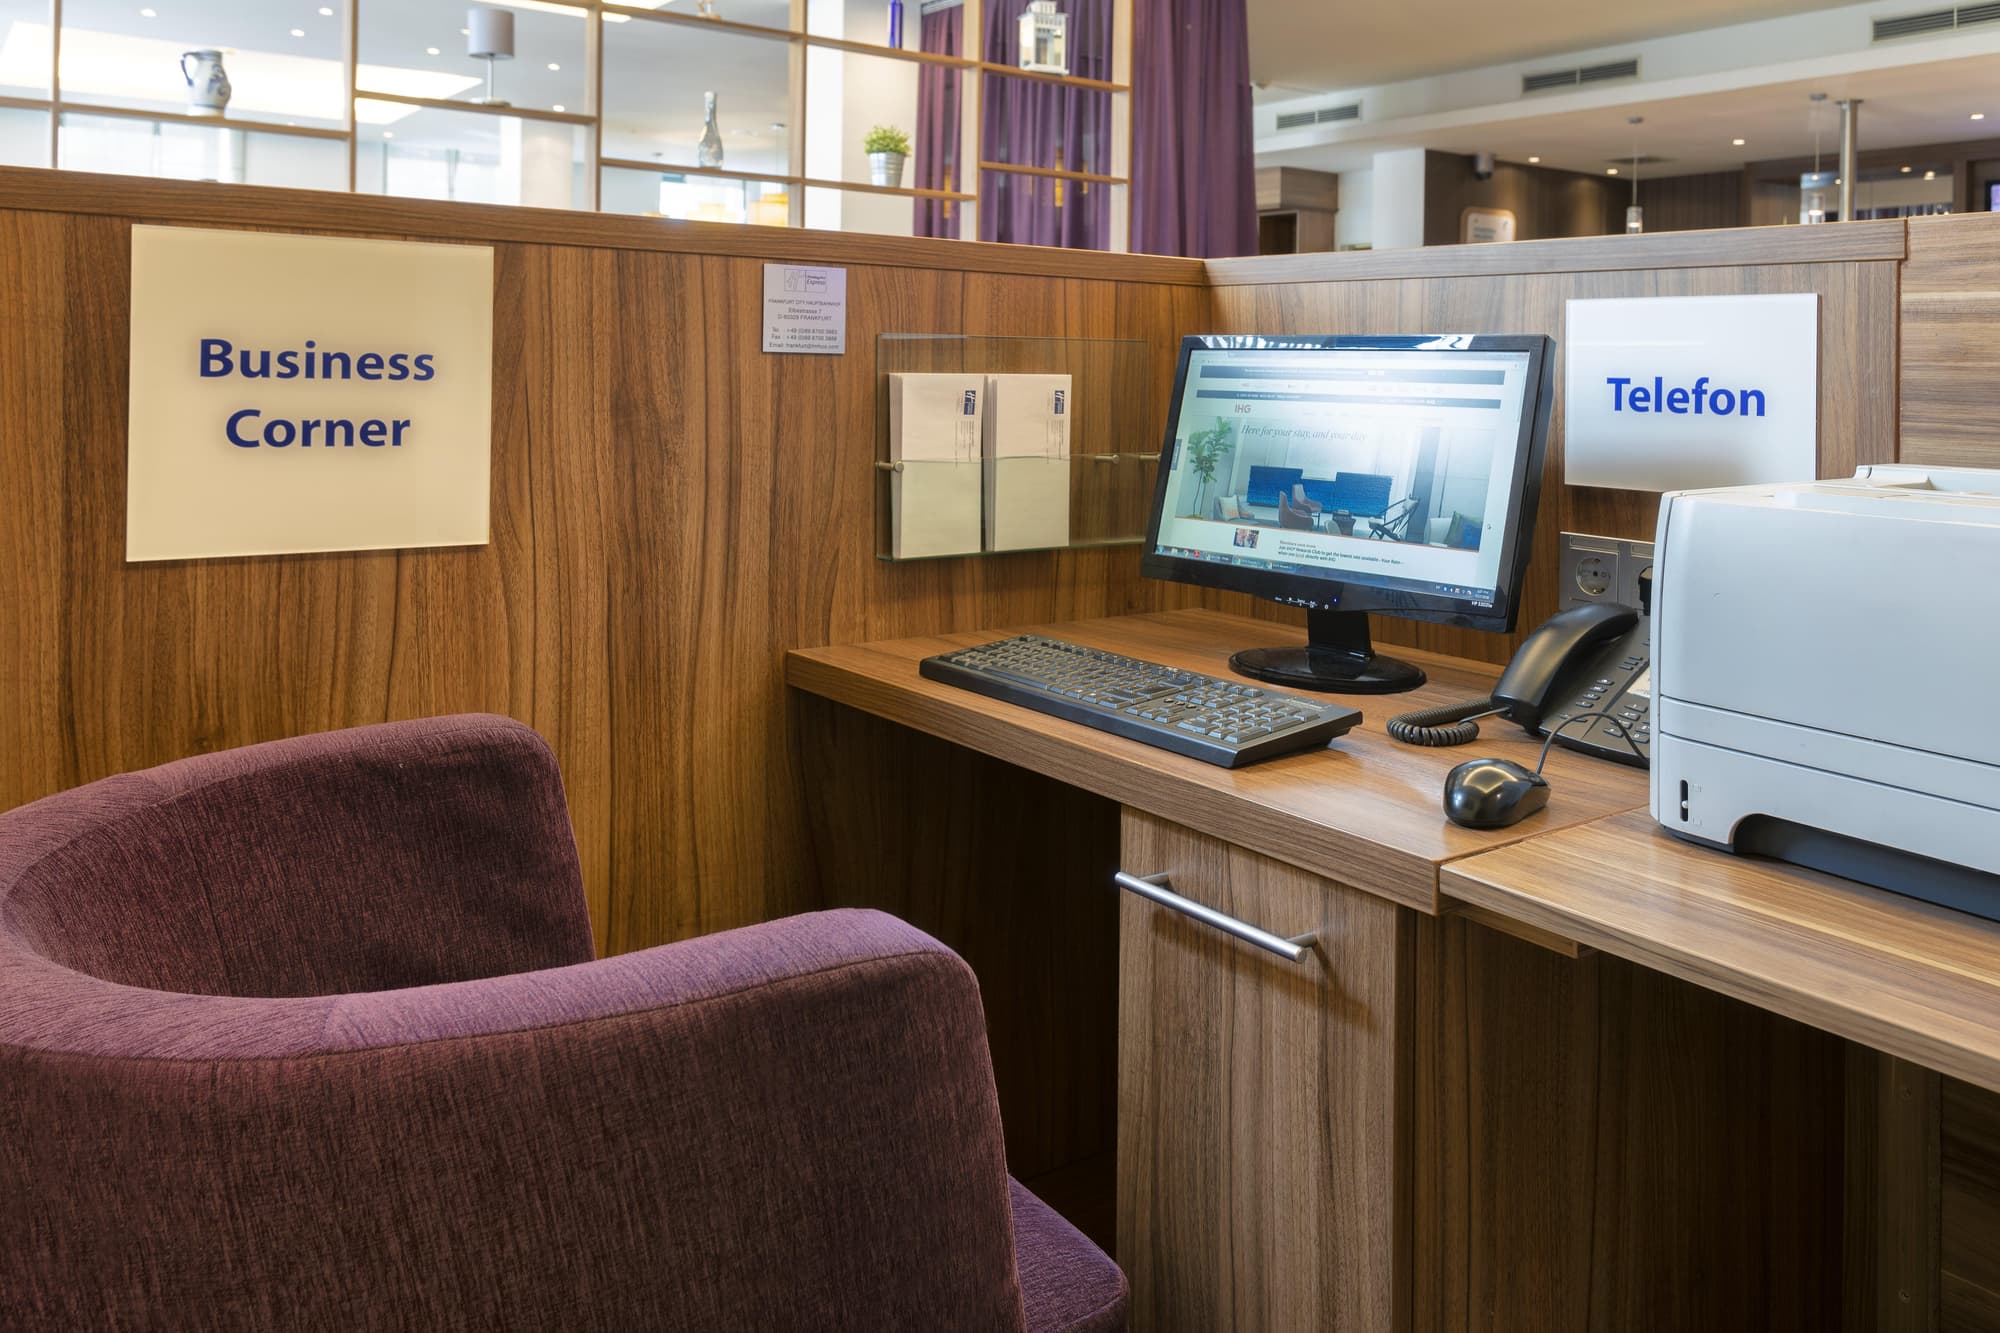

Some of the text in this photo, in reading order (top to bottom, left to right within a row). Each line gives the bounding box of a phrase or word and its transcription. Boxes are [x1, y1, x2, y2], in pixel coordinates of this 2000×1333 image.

[199, 338, 435, 382] Business
[1234, 404, 1252, 414] IHG
[1606, 376, 1766, 416] Telefon
[226, 408, 410, 448] Corner
[1241, 425, 1259, 435] Here
[1258, 426, 1273, 437] for
[1272, 429, 1293, 438] your
[1312, 429, 1329, 439] and
